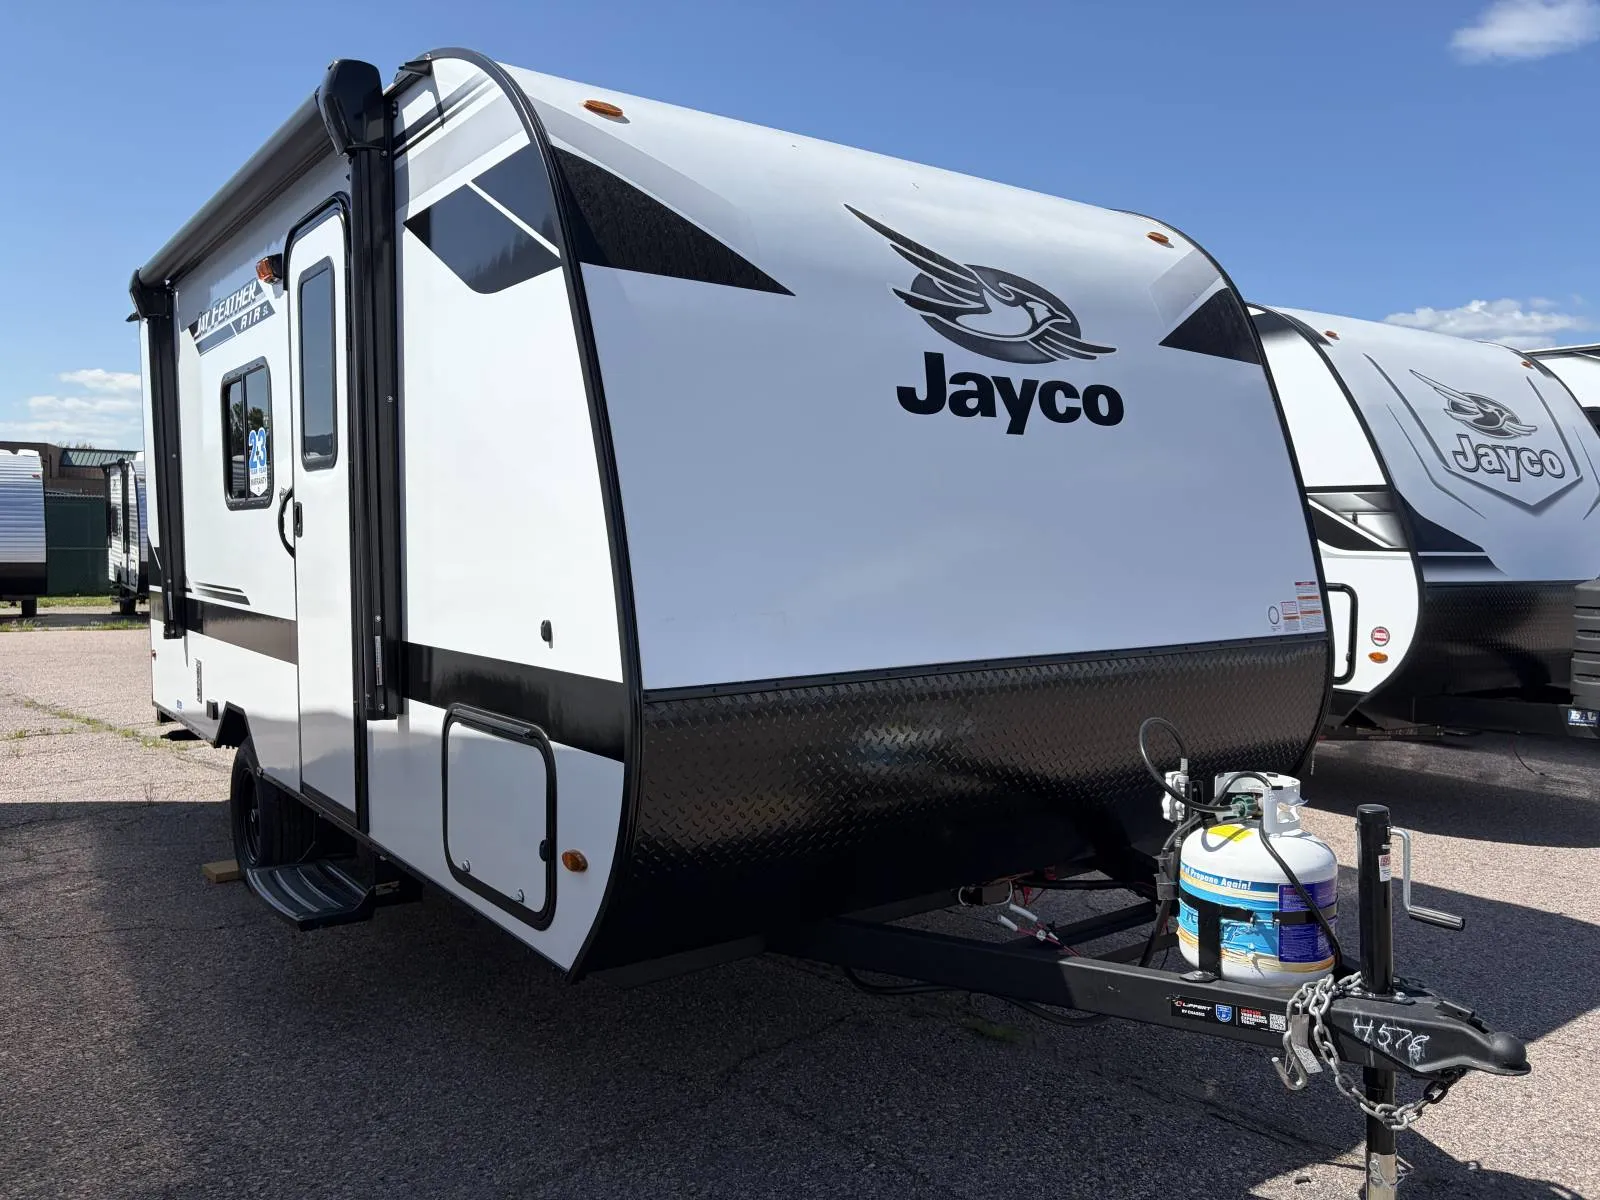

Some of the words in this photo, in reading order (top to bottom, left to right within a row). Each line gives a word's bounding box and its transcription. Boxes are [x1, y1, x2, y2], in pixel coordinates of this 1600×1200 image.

[211, 280, 257, 328] FEATHER
[241, 306, 261, 330] AIR
[896, 351, 1124, 436] Jayco
[1452, 433, 1565, 482] Jayco
[1190, 869, 1219, 885] Propane
[1220, 877, 1252, 890] Again!
